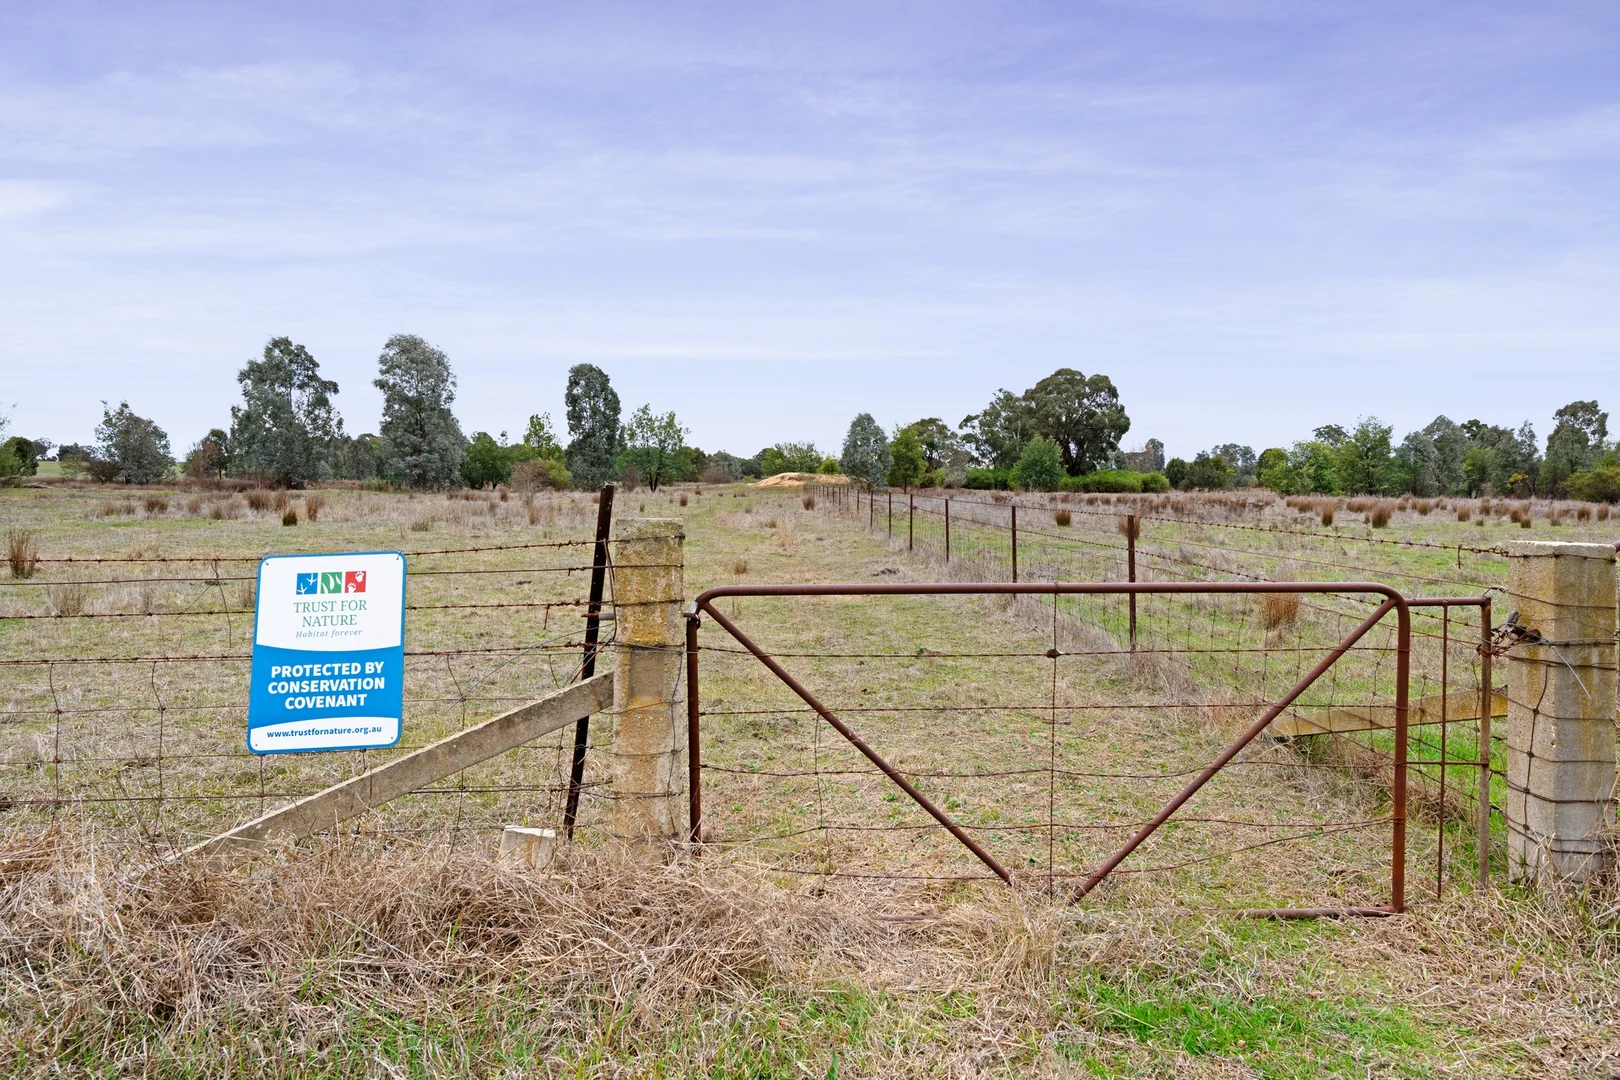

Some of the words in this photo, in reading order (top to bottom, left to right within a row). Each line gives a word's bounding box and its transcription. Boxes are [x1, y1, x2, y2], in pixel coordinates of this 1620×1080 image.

[293, 600, 337, 613] TRUST
[340, 599, 368, 611] FOR
[302, 614, 358, 627] NATURE
[295, 630, 328, 638] Habitat
[330, 629, 363, 638] forever
[271, 662, 361, 678] PROTECTED
[365, 661, 385, 674] BY
[267, 677, 385, 694] CONSERVATION
[284, 693, 368, 710] COVENANT
[266, 725, 382, 738] www.trustfornature.org.au
